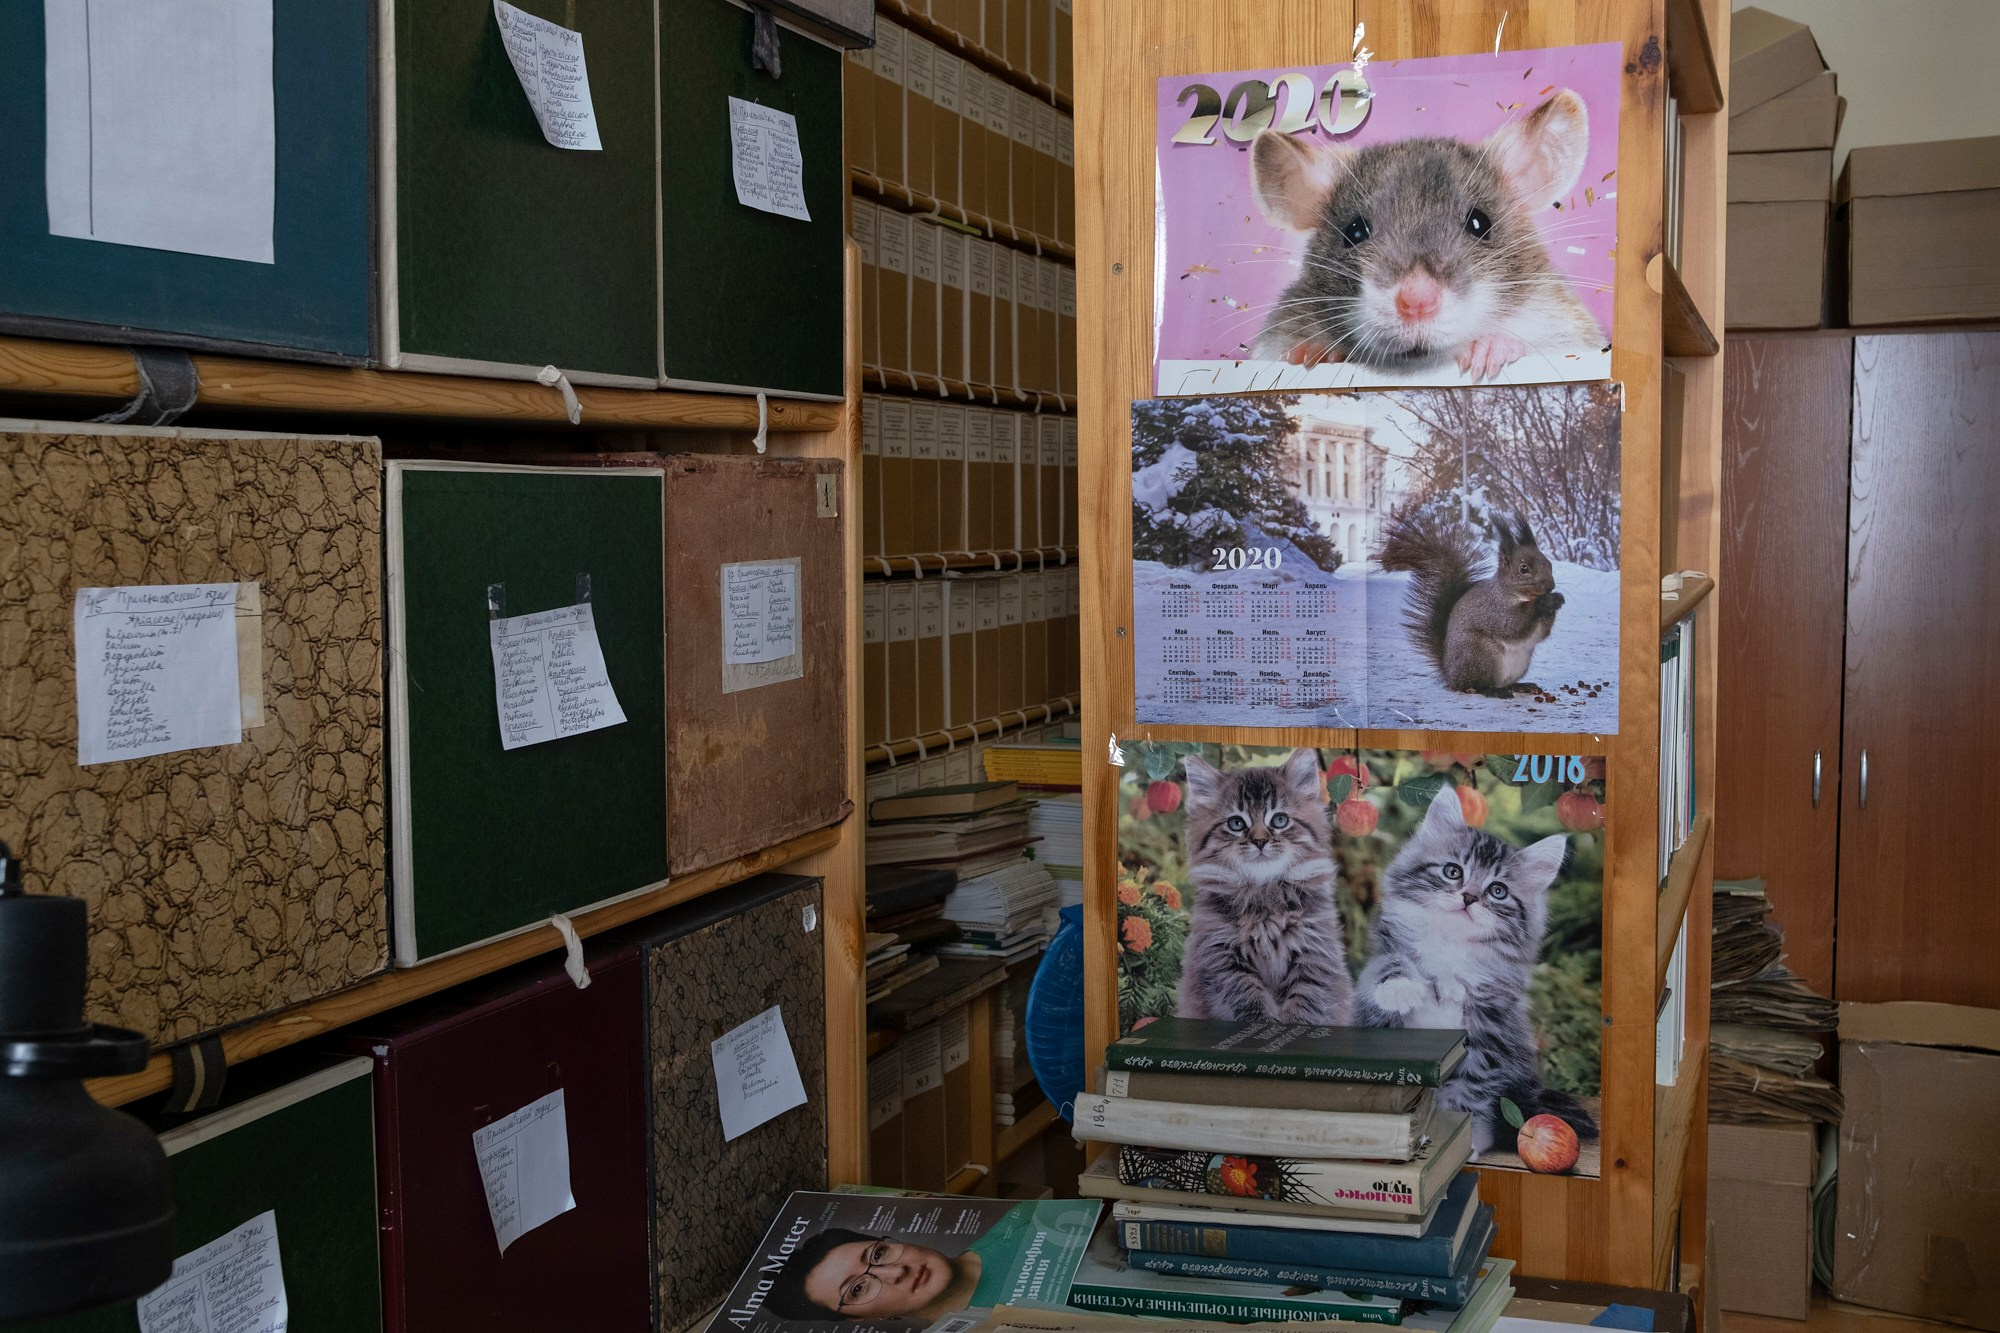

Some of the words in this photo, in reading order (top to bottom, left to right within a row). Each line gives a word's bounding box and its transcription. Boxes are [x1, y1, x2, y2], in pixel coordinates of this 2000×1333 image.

[1171, 70, 1372, 145] 2020
[1212, 547, 1282, 570] 2020
[1304, 582, 1328, 590] Апрель
[1305, 629, 1326, 637] Август
[1212, 669, 1238, 677] Октябрь
[1512, 755, 1585, 784] 2018
[728, 1279, 775, 1330] Alma
[758, 1216, 811, 1274] Mater
[1073, 1293, 1144, 1310] РАСТЕНИЯ
[1146, 1299, 1236, 1317] ГОРШЕЧНЫЕ
[1238, 1306, 1248, 1317] И
